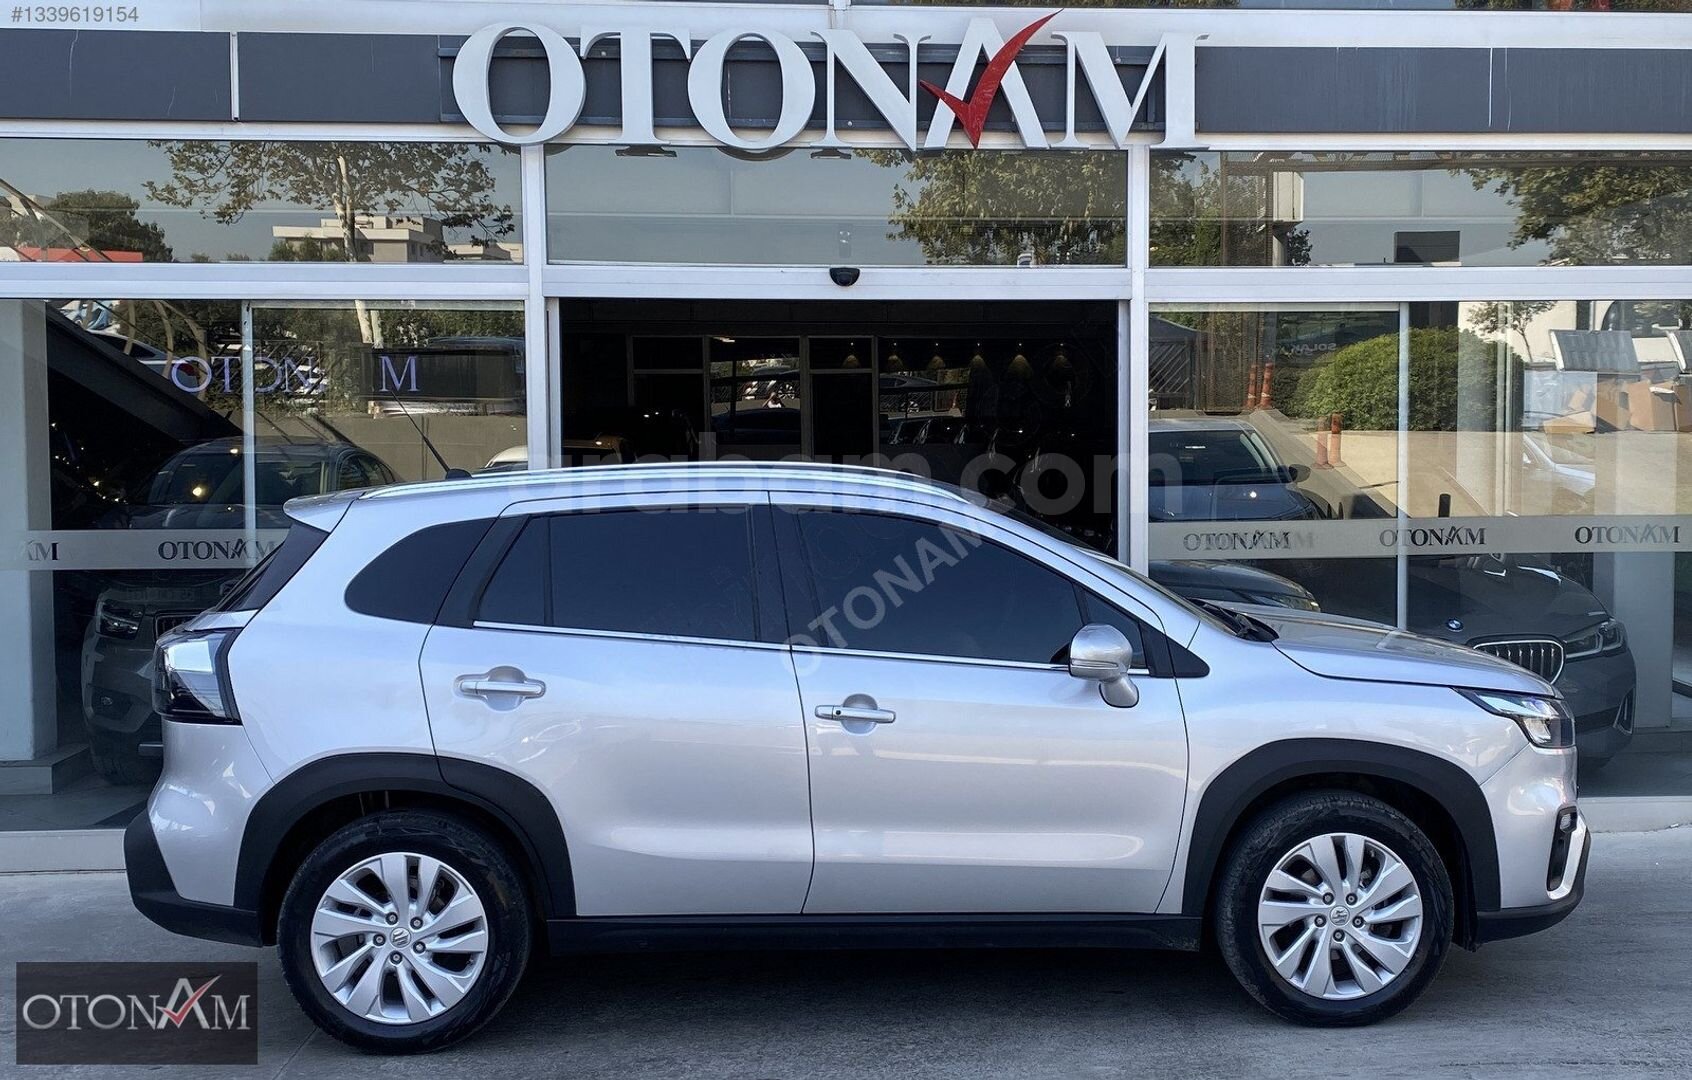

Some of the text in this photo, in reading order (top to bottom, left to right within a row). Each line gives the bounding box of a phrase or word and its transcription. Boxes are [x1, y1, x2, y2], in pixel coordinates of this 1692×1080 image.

[452, 15, 1209, 151] OTONAM
[1183, 530, 1290, 551] OTONAM
[1379, 525, 1487, 547] OTONAM
[1574, 523, 1680, 545] OTONAM
